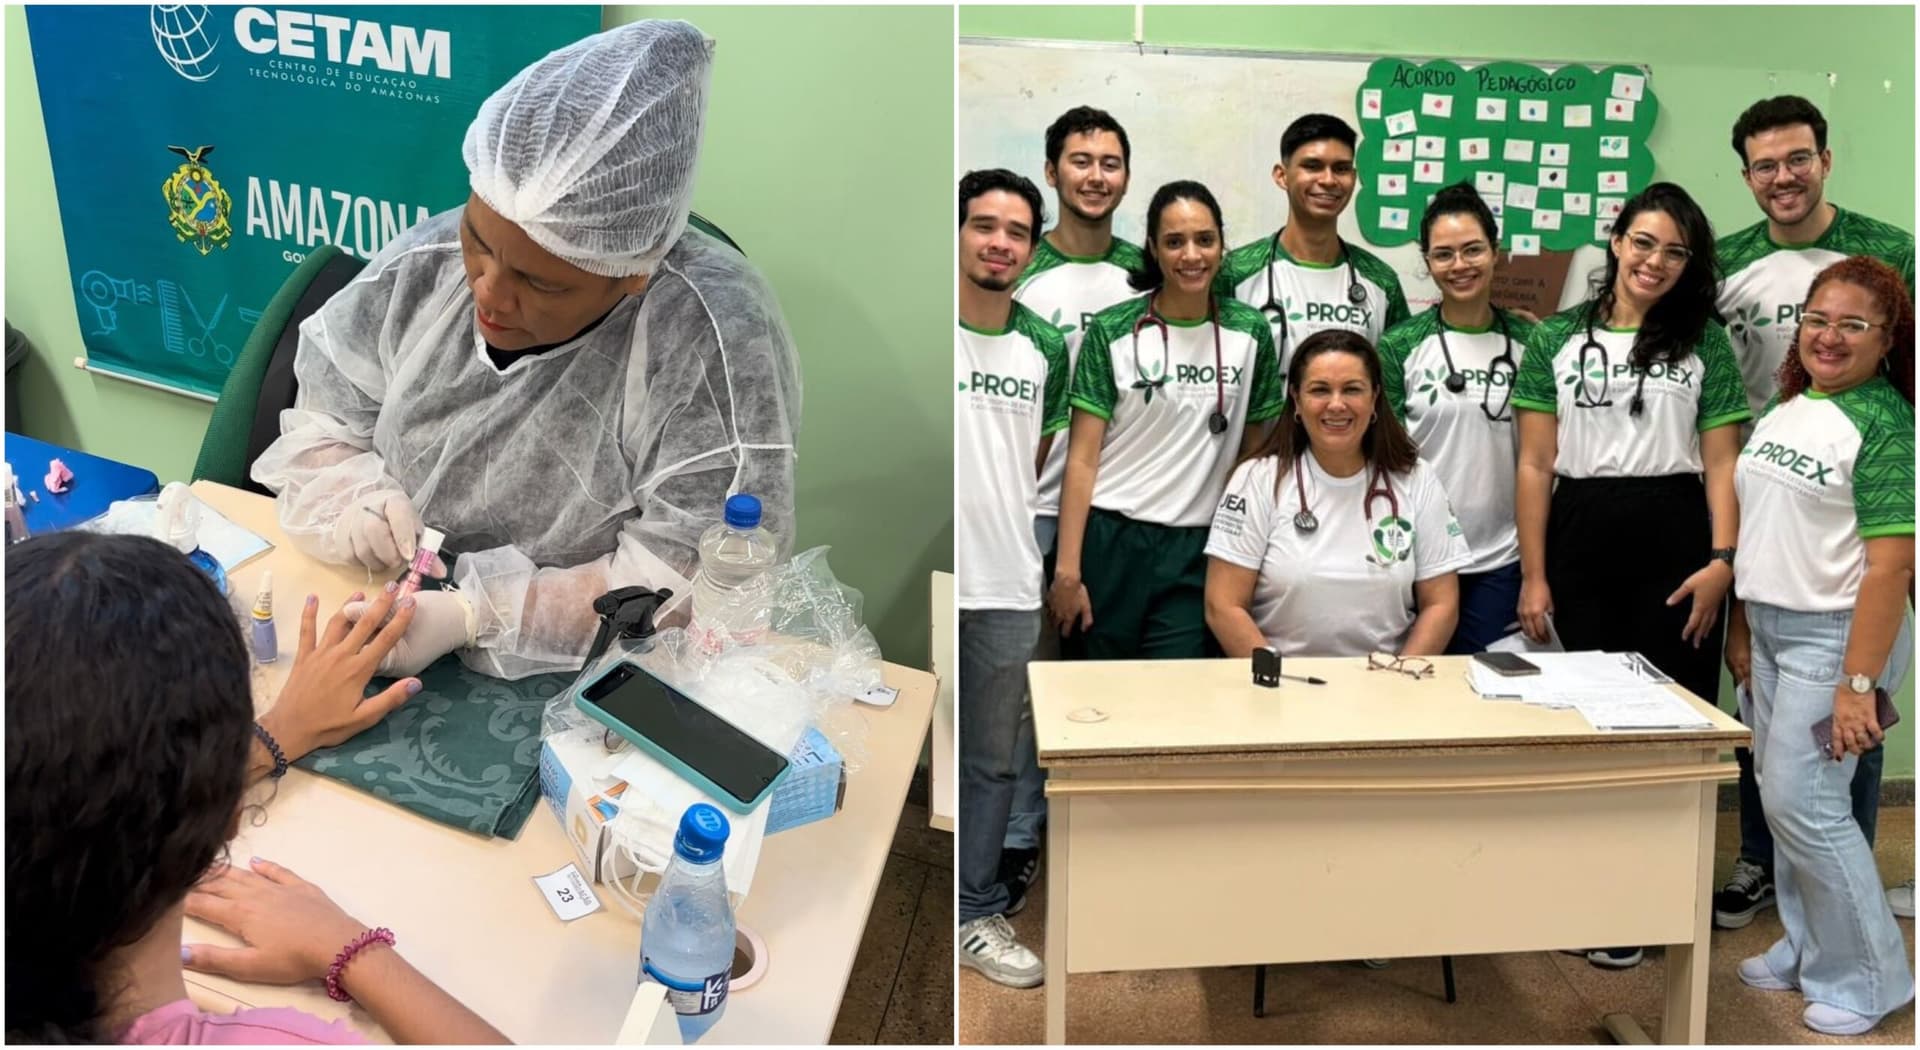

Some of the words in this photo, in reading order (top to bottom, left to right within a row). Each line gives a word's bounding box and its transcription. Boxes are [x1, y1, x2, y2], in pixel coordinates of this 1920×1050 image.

[233, 7, 451, 79] CETAM
[249, 67, 337, 88] TECNOLÓGICA
[345, 82, 361, 92] DO
[371, 86, 440, 104] AMAZONAS
[269, 59, 317, 74] CENTRO
[326, 67, 340, 77] DE
[349, 71, 417, 89] EDUCAÇÃO
[1391, 64, 1456, 89] ACORDO
[1476, 67, 1576, 93] PEDAGÓGICO
[1307, 302, 1372, 329] PROEX
[1176, 364, 1244, 386] PROEX
[1753, 441, 1834, 487] PROEX
[556, 887, 575, 903] 23
